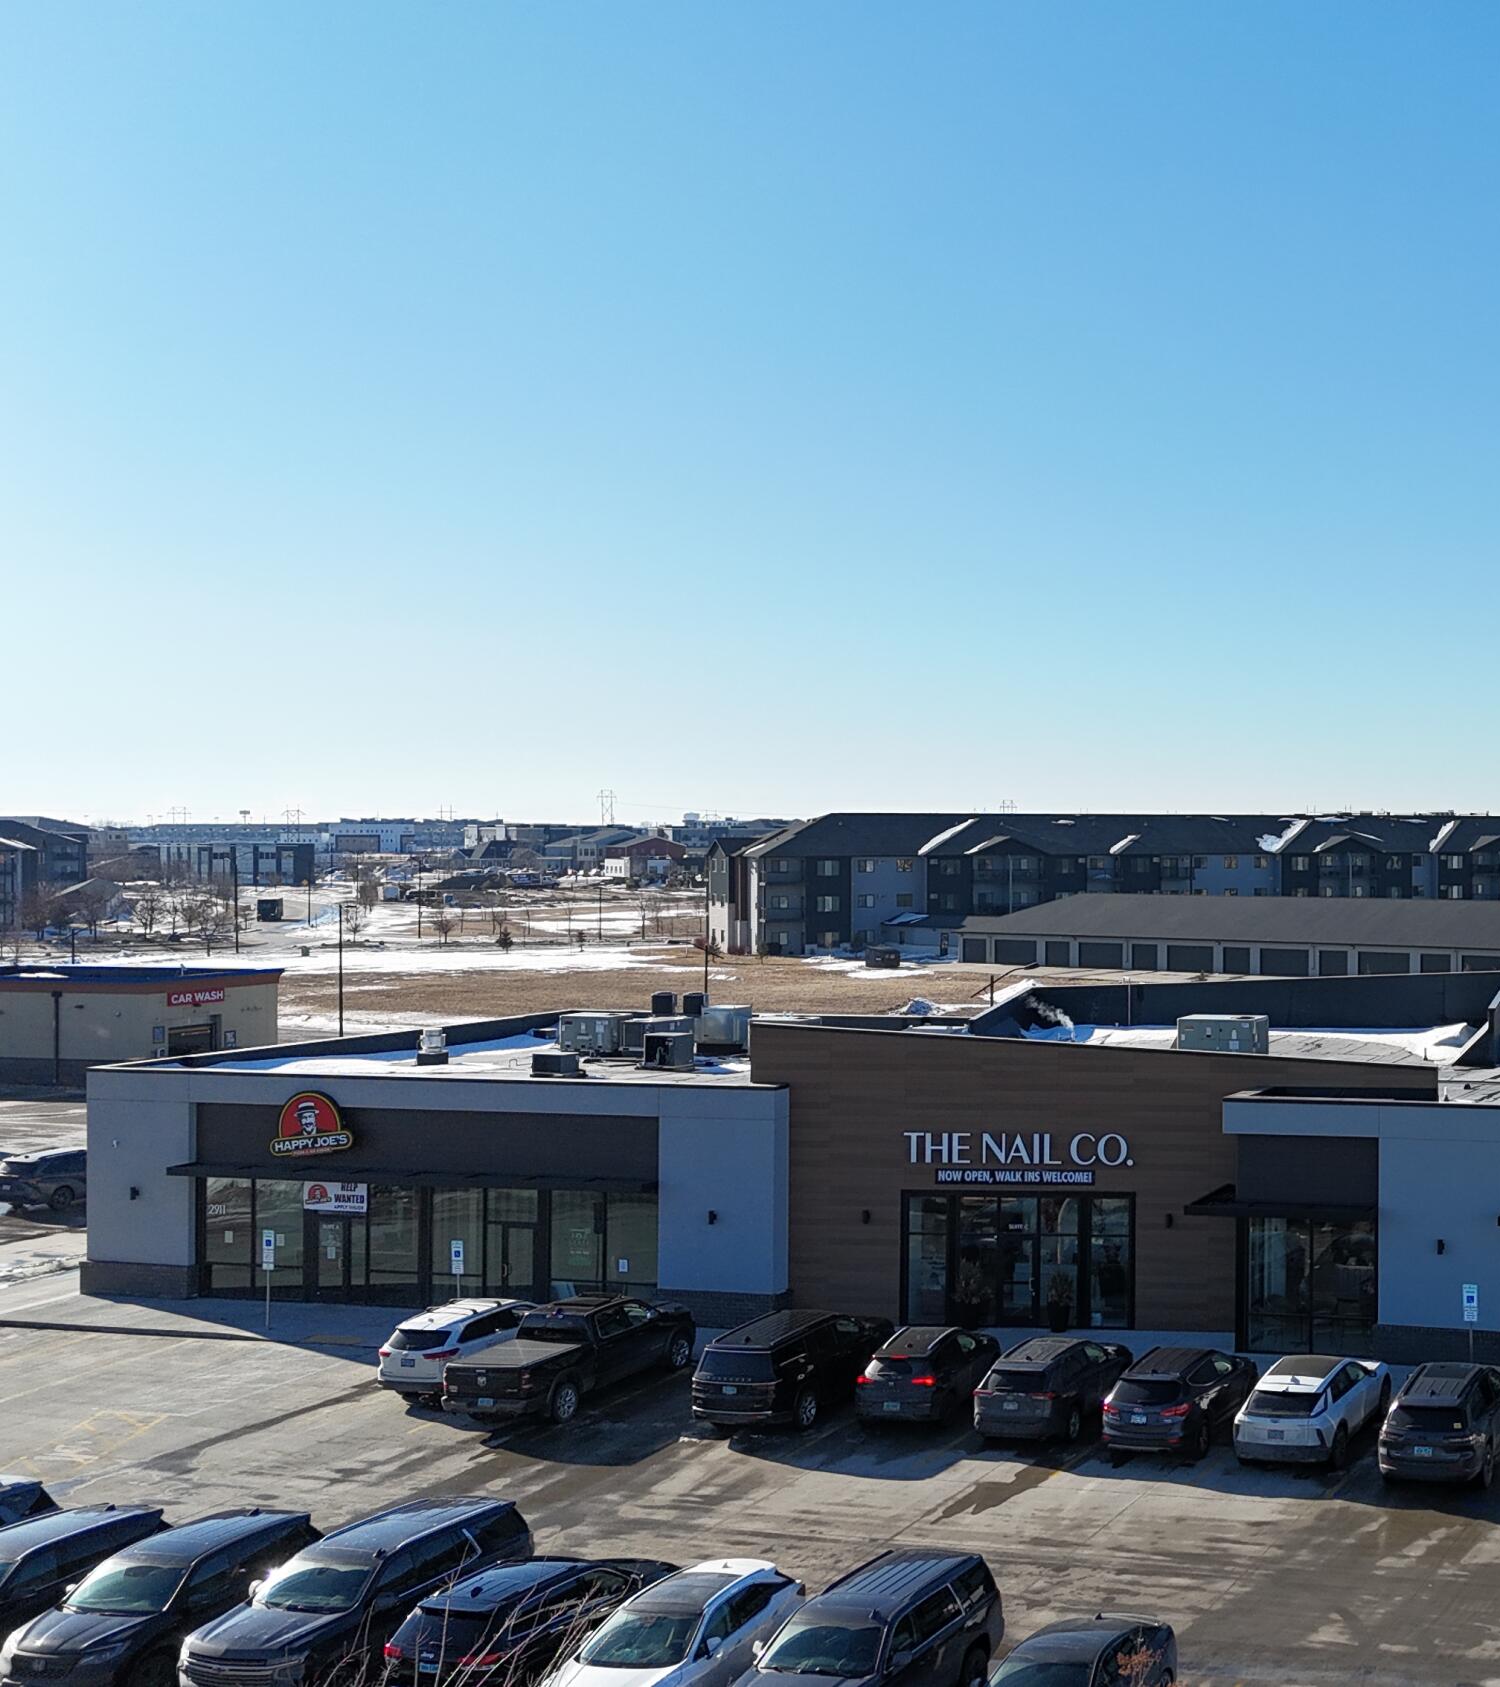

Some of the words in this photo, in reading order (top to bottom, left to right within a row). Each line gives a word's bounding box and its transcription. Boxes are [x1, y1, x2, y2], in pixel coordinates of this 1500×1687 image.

[171, 994, 192, 1004] CAR
[195, 991, 224, 1002] WASH
[275, 1138, 313, 1151] HAPPY
[314, 1134, 348, 1147] JOE'S
[904, 1132, 971, 1164] THE
[982, 1132, 1062, 1165] NAIL
[1070, 1133, 1134, 1166] CO.
[938, 1171, 963, 1182] NOW
[964, 1171, 993, 1184] OPEN,
[995, 1171, 1023, 1182] WALK
[1024, 1171, 1041, 1183] INS
[1043, 1171, 1092, 1183] WELCOME!
[341, 1182, 358, 1192] HELP
[334, 1193, 365, 1204] WANTED
[208, 1204, 226, 1214] 2911
